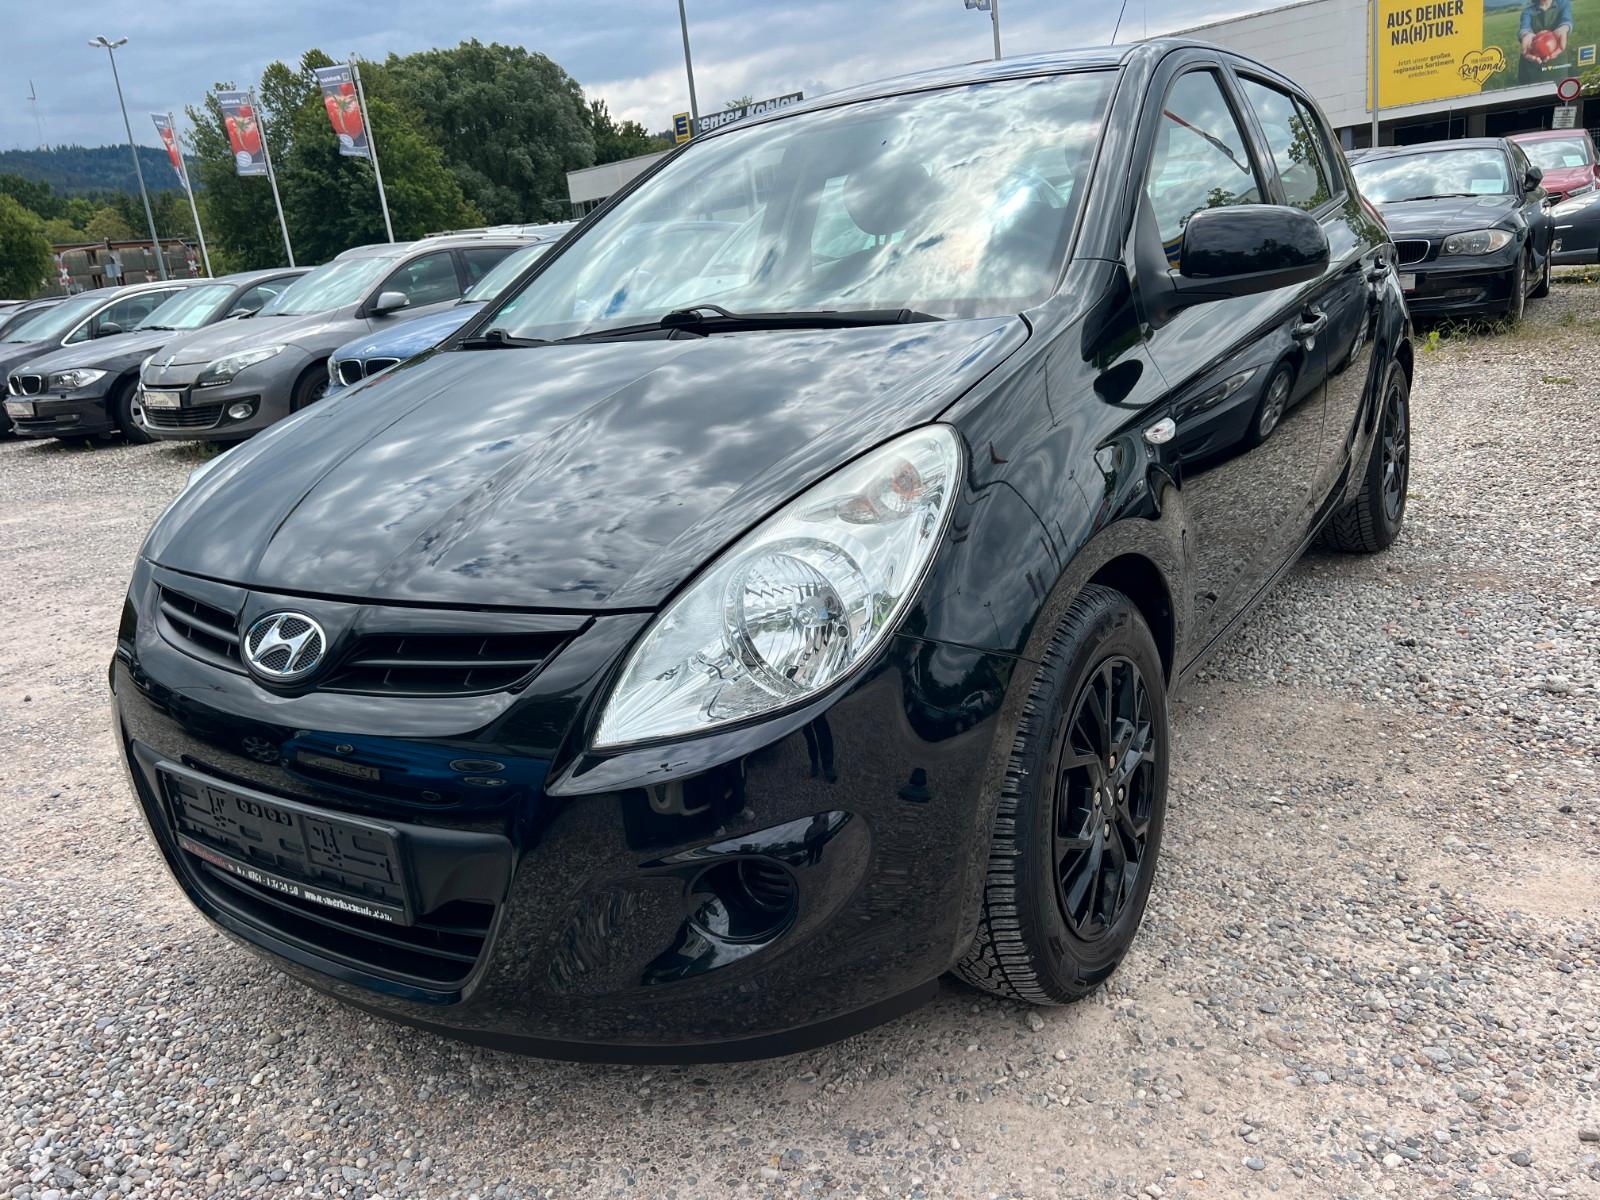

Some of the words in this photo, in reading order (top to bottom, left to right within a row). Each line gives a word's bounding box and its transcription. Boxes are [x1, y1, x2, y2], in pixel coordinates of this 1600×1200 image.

[1387, 9, 1412, 28] AUS
[1416, 0, 1464, 23] DEINER
[1391, 20, 1459, 46] NA(H)TUR.
[1424, 58, 1455, 68] Sortiment
[1458, 59, 1505, 78] Regional
[676, 116, 689, 136] E
[698, 109, 742, 131] enter
